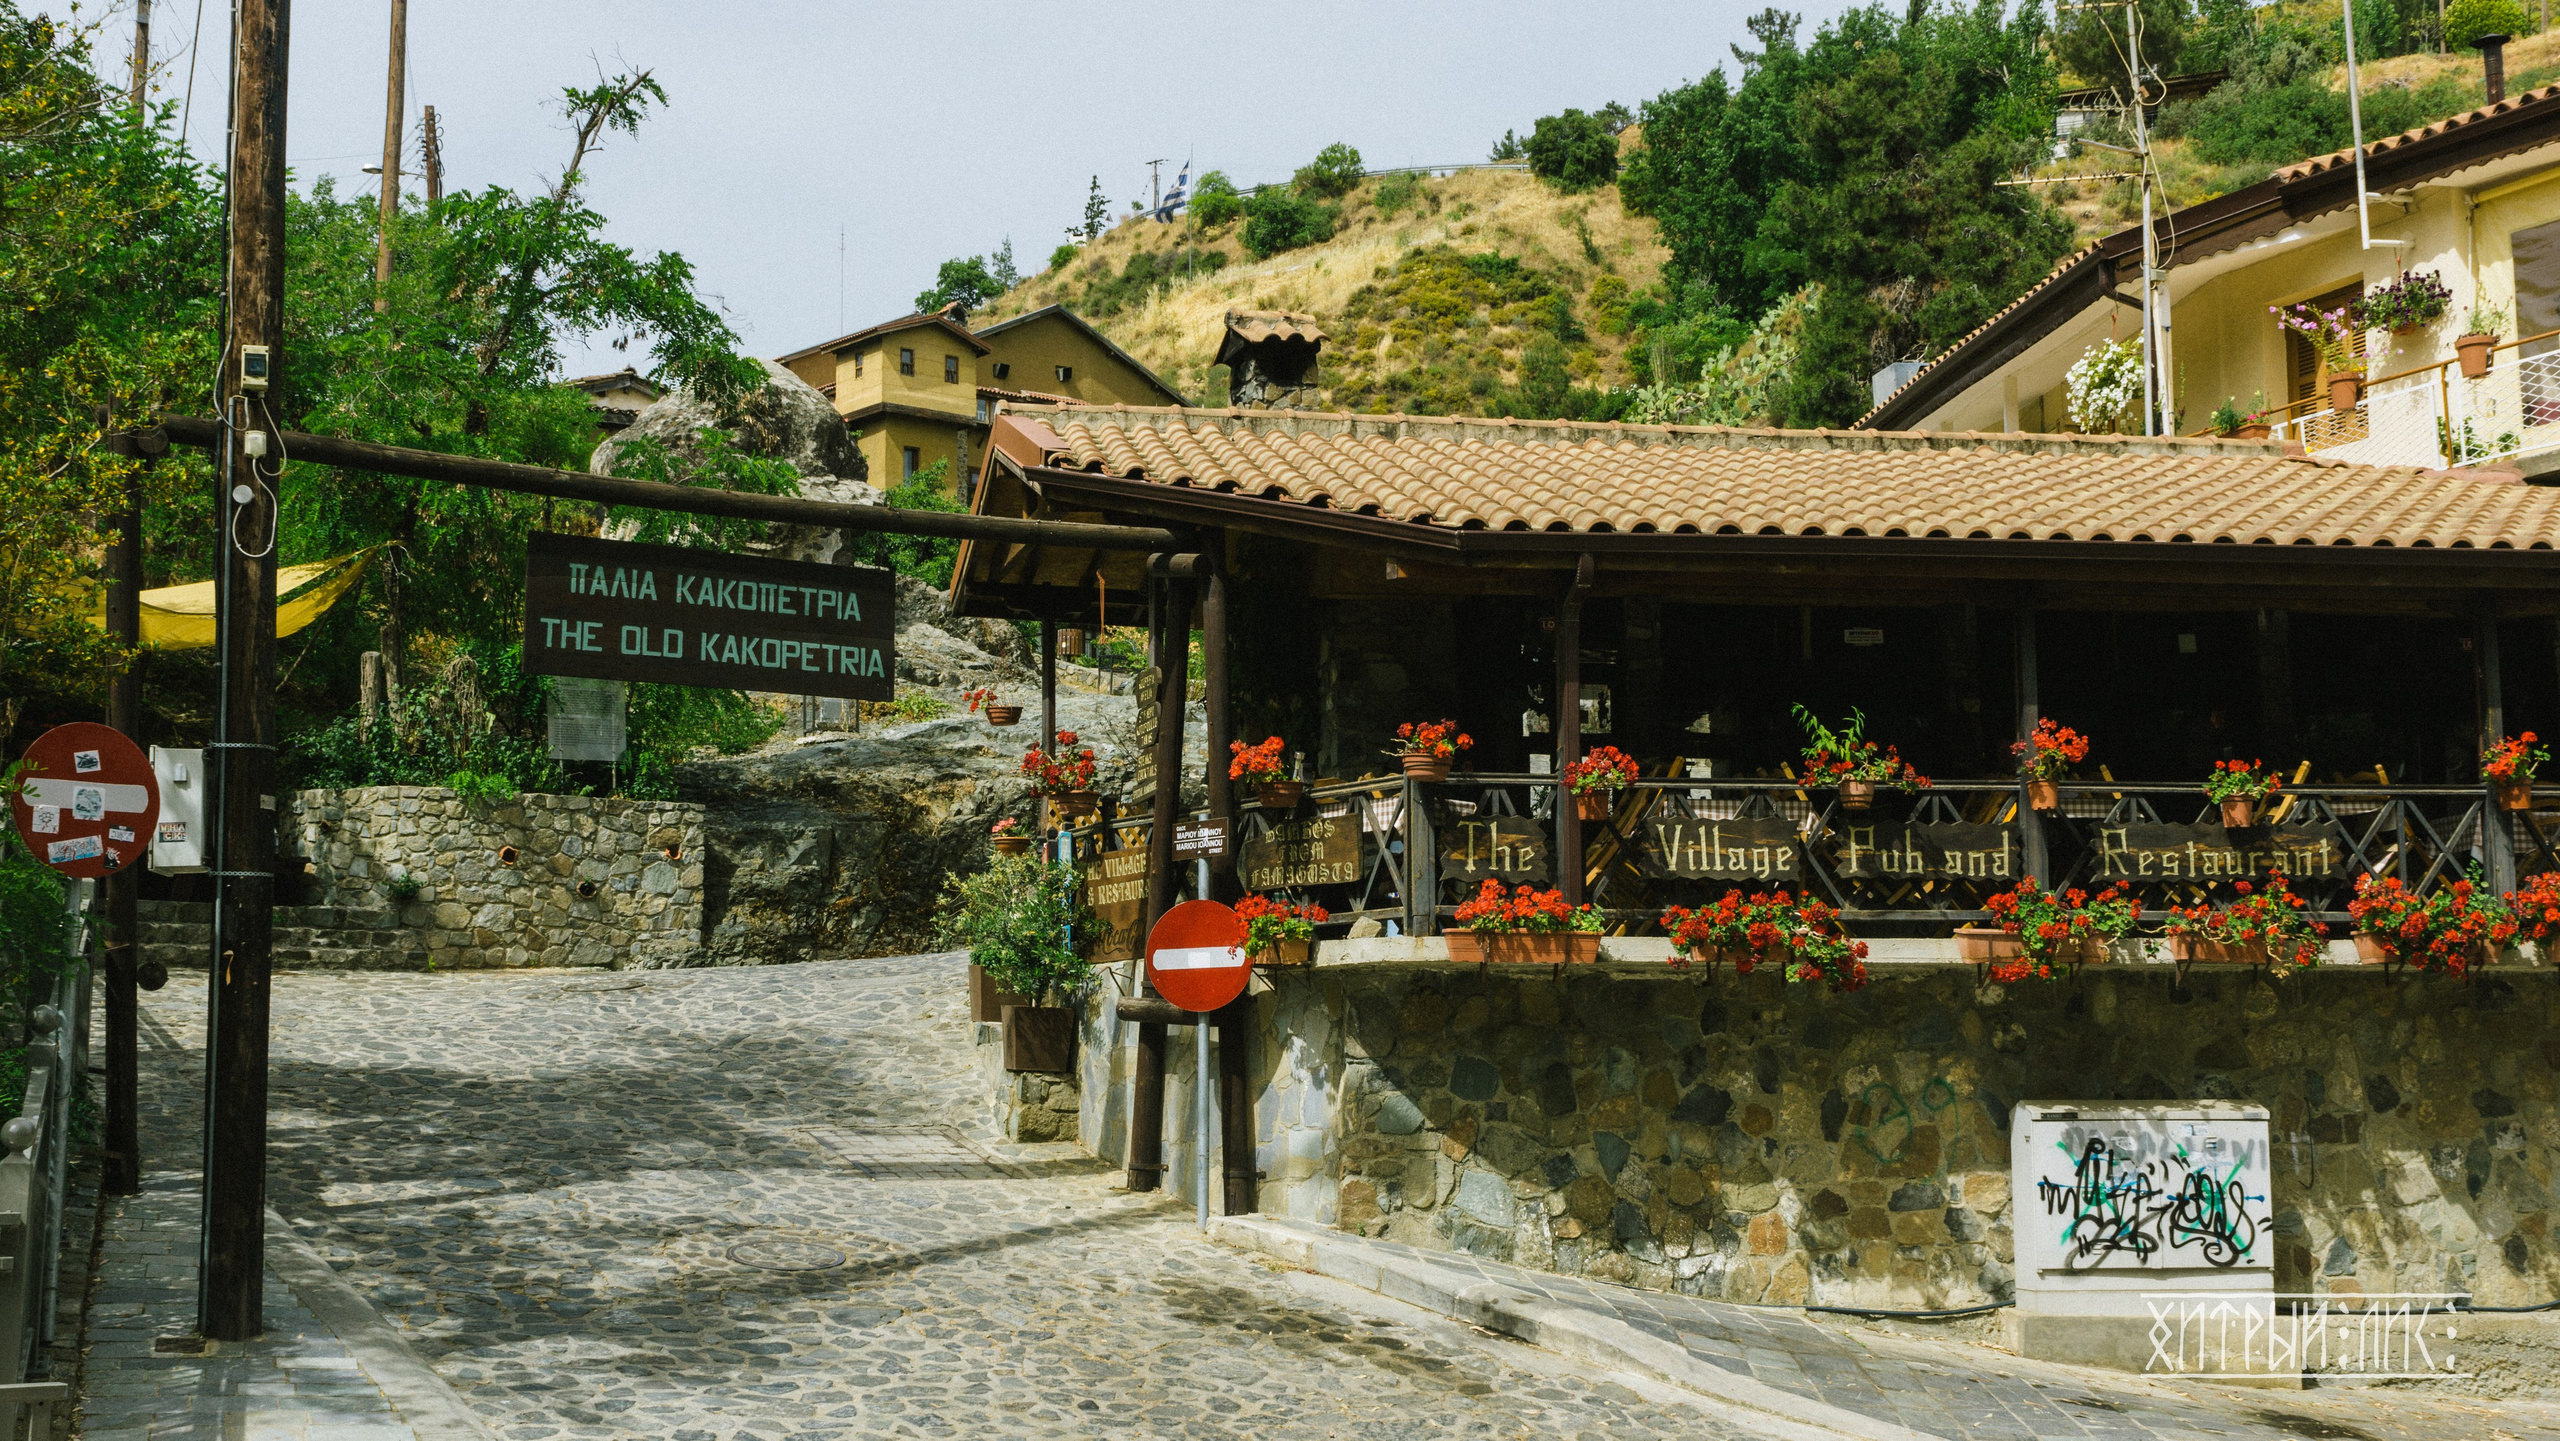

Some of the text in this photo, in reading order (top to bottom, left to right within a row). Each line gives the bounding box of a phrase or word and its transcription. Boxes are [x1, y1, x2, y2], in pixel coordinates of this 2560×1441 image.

[569, 562, 861, 622] ΠΑΛΙΑ ΚΑΚΟΠΕΤΡΙΑ
[540, 617, 885, 678] THE OLD KAKOPETRIA
[1087, 852, 1147, 881] HE VILLAGE
[1176, 841, 1197, 851] MARIOU
[1457, 820, 2333, 879] The Village Pub and Restaurant
[1251, 861, 1353, 888] FAMAGUSTA
